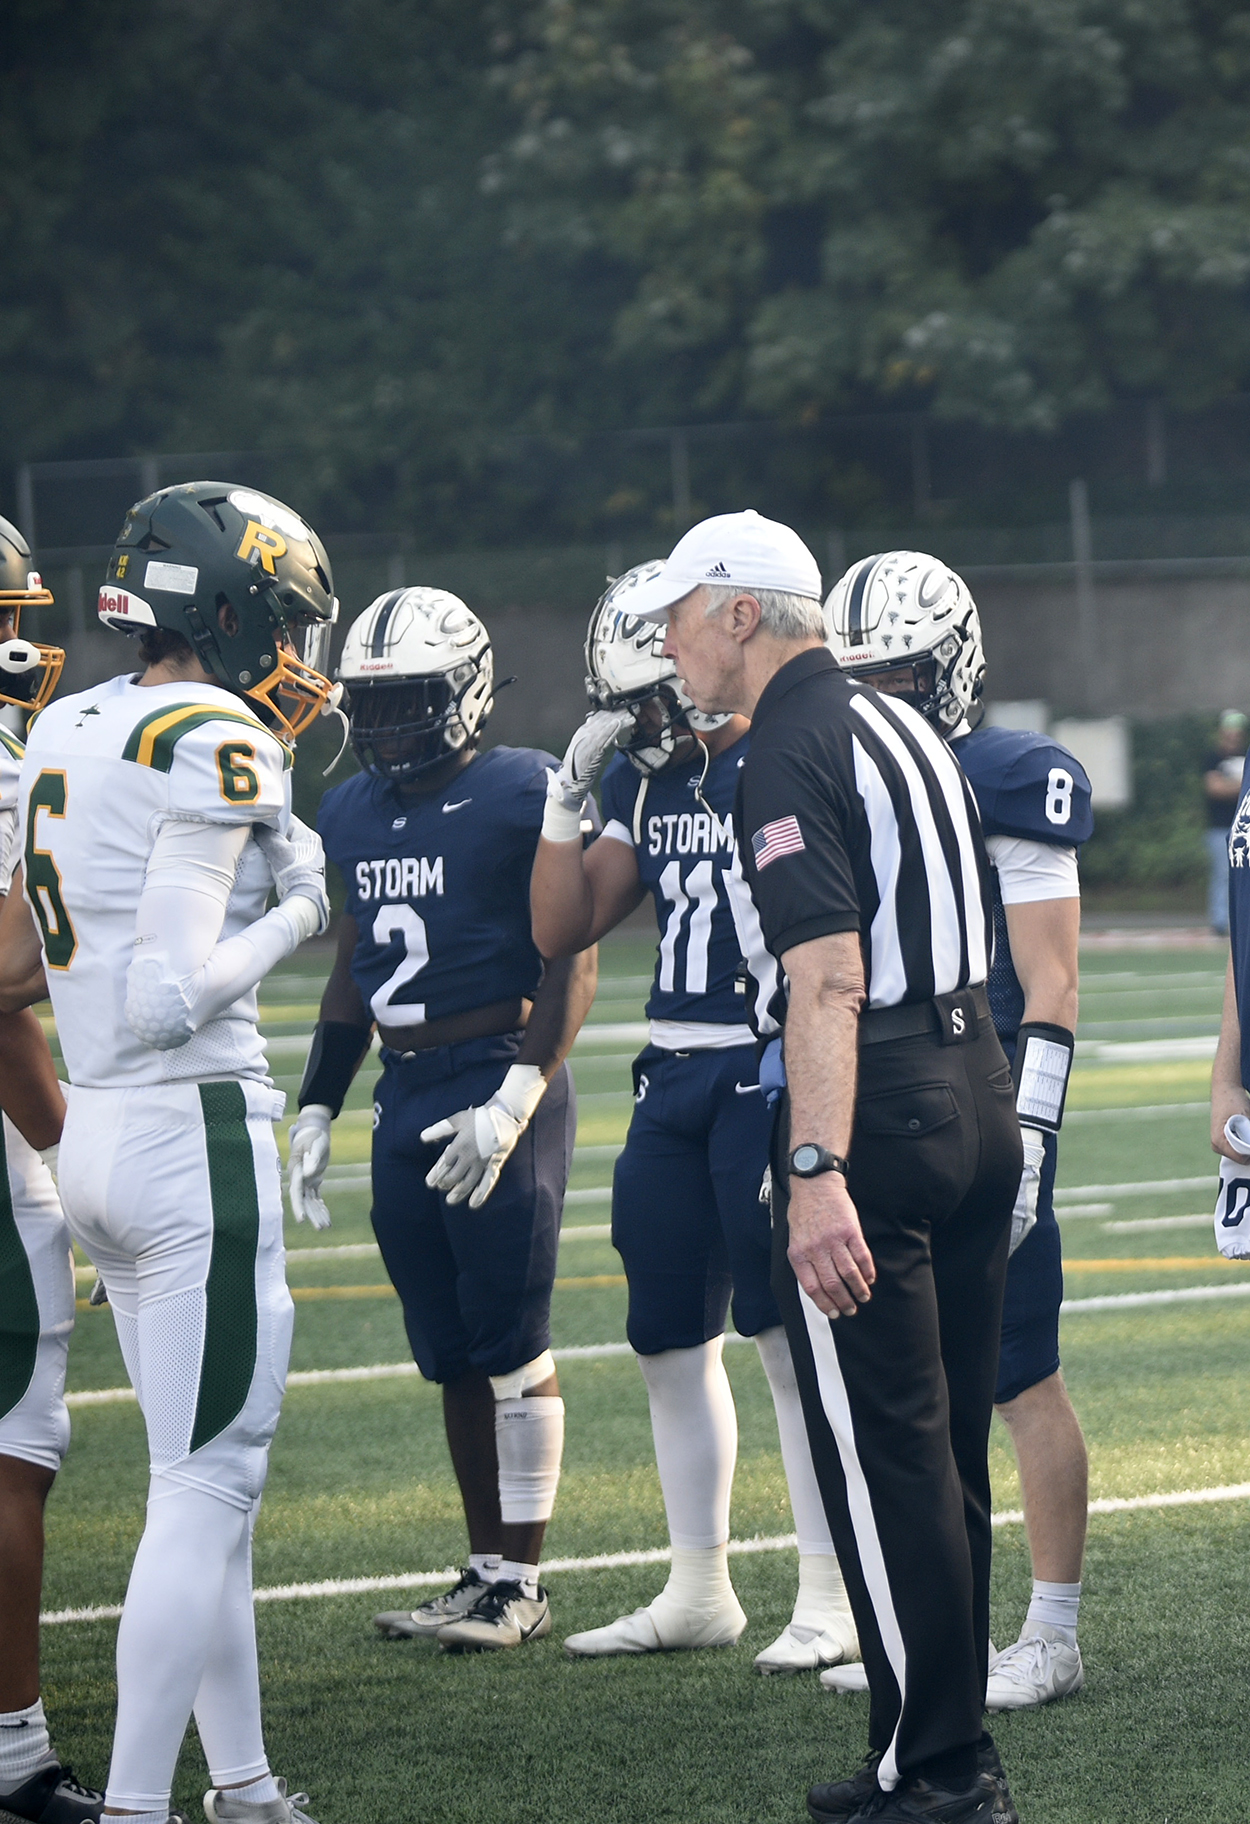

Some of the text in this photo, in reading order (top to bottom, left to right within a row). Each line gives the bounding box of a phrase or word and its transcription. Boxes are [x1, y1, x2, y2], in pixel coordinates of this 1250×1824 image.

[237, 519, 287, 575] R
[214, 739, 262, 806] 6
[1044, 766, 1075, 826] 8
[648, 812, 735, 857] STORM
[23, 767, 79, 972] 6
[355, 856, 445, 901] STORM
[658, 860, 719, 994] 11
[370, 903, 430, 1028] 2
[950, 1007, 966, 1035] S
